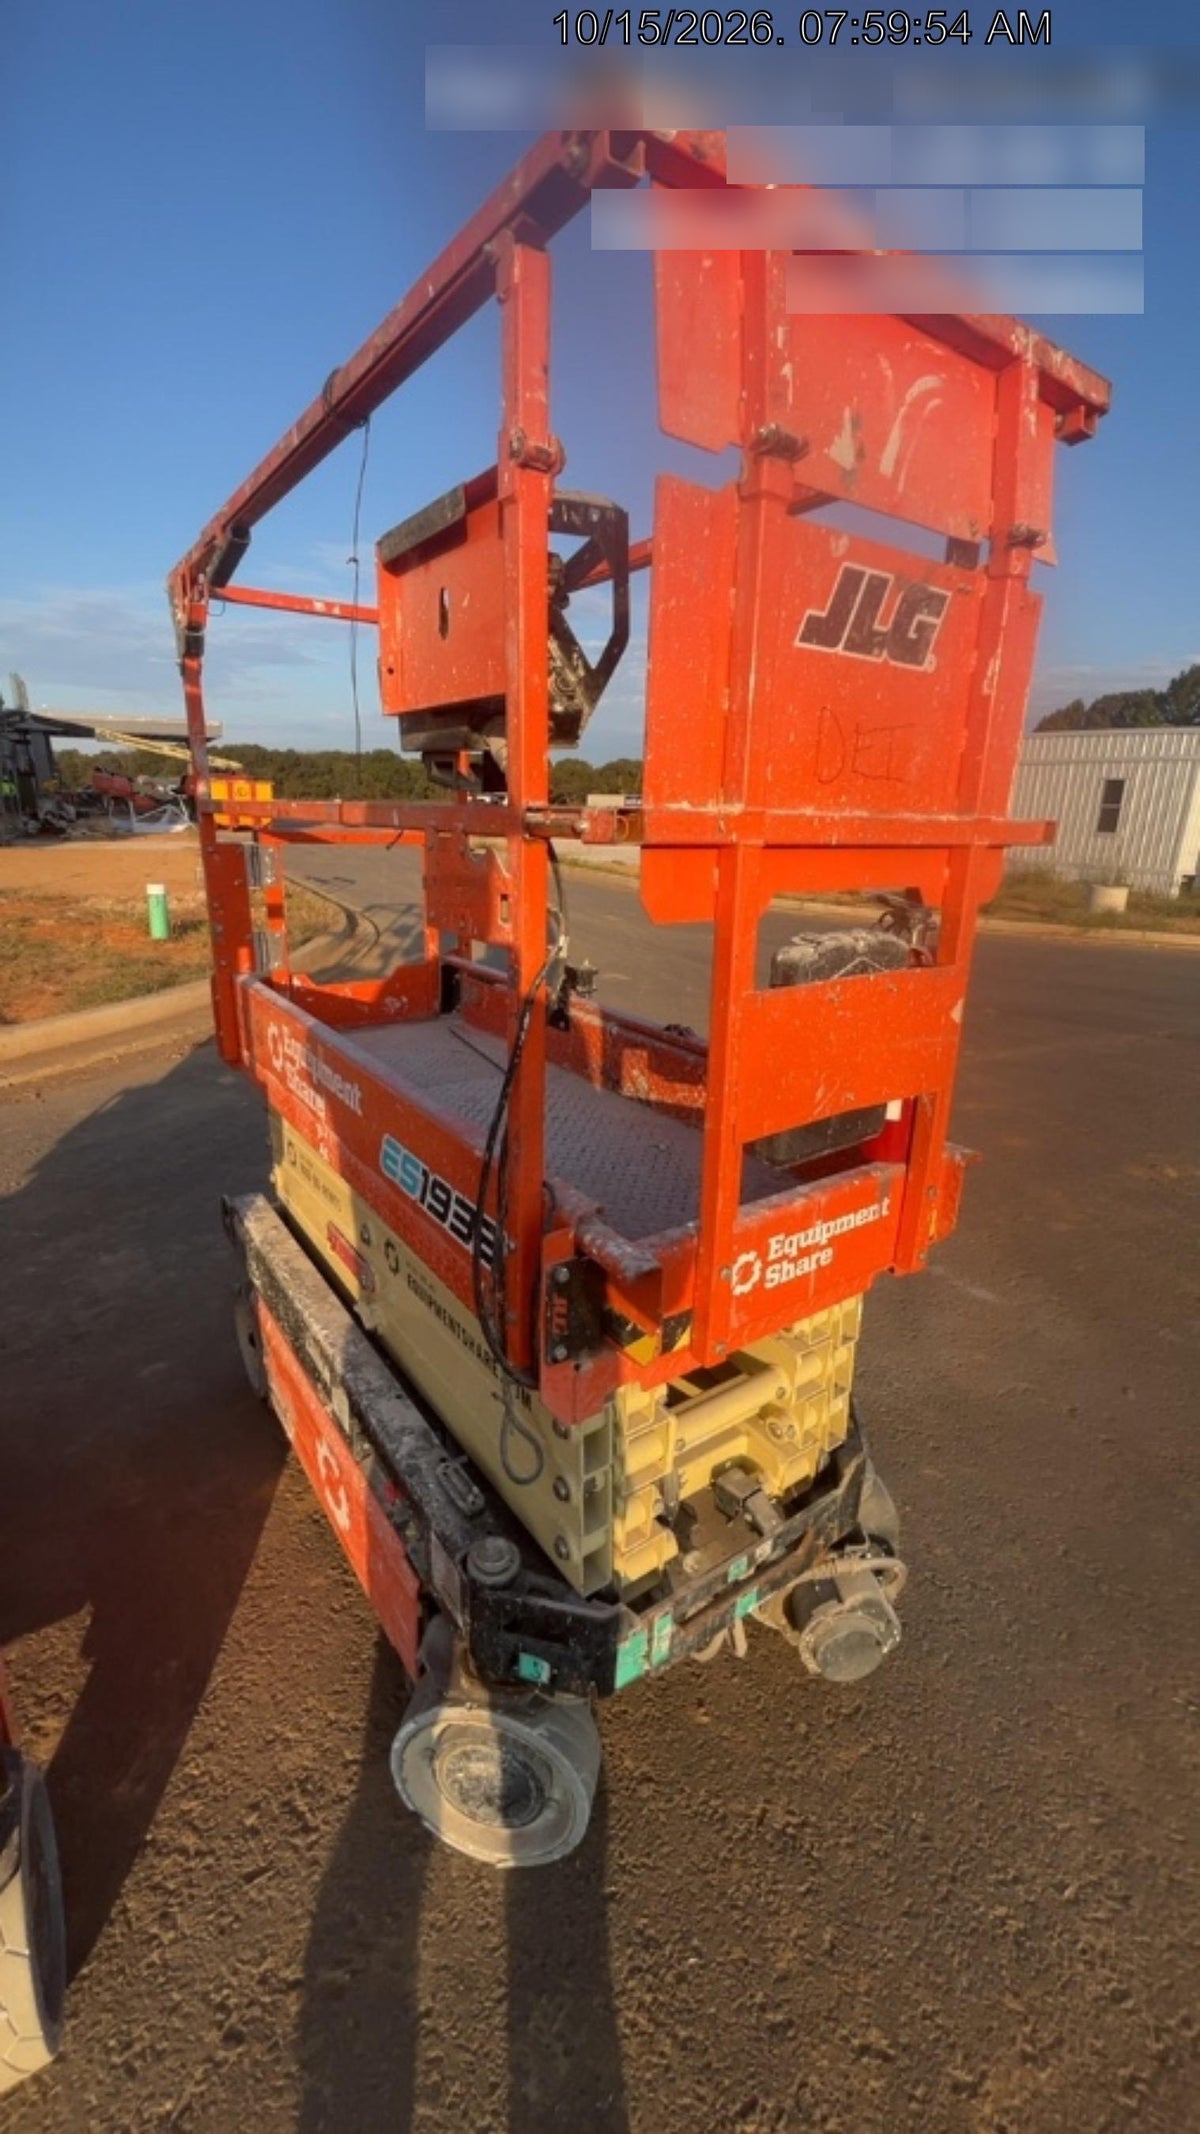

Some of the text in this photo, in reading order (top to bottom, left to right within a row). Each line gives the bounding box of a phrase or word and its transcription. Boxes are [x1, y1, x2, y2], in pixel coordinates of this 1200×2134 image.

[794, 561, 952, 671] JLG
[768, 1197, 890, 1261] Equipment
[764, 1247, 834, 1290] Share
